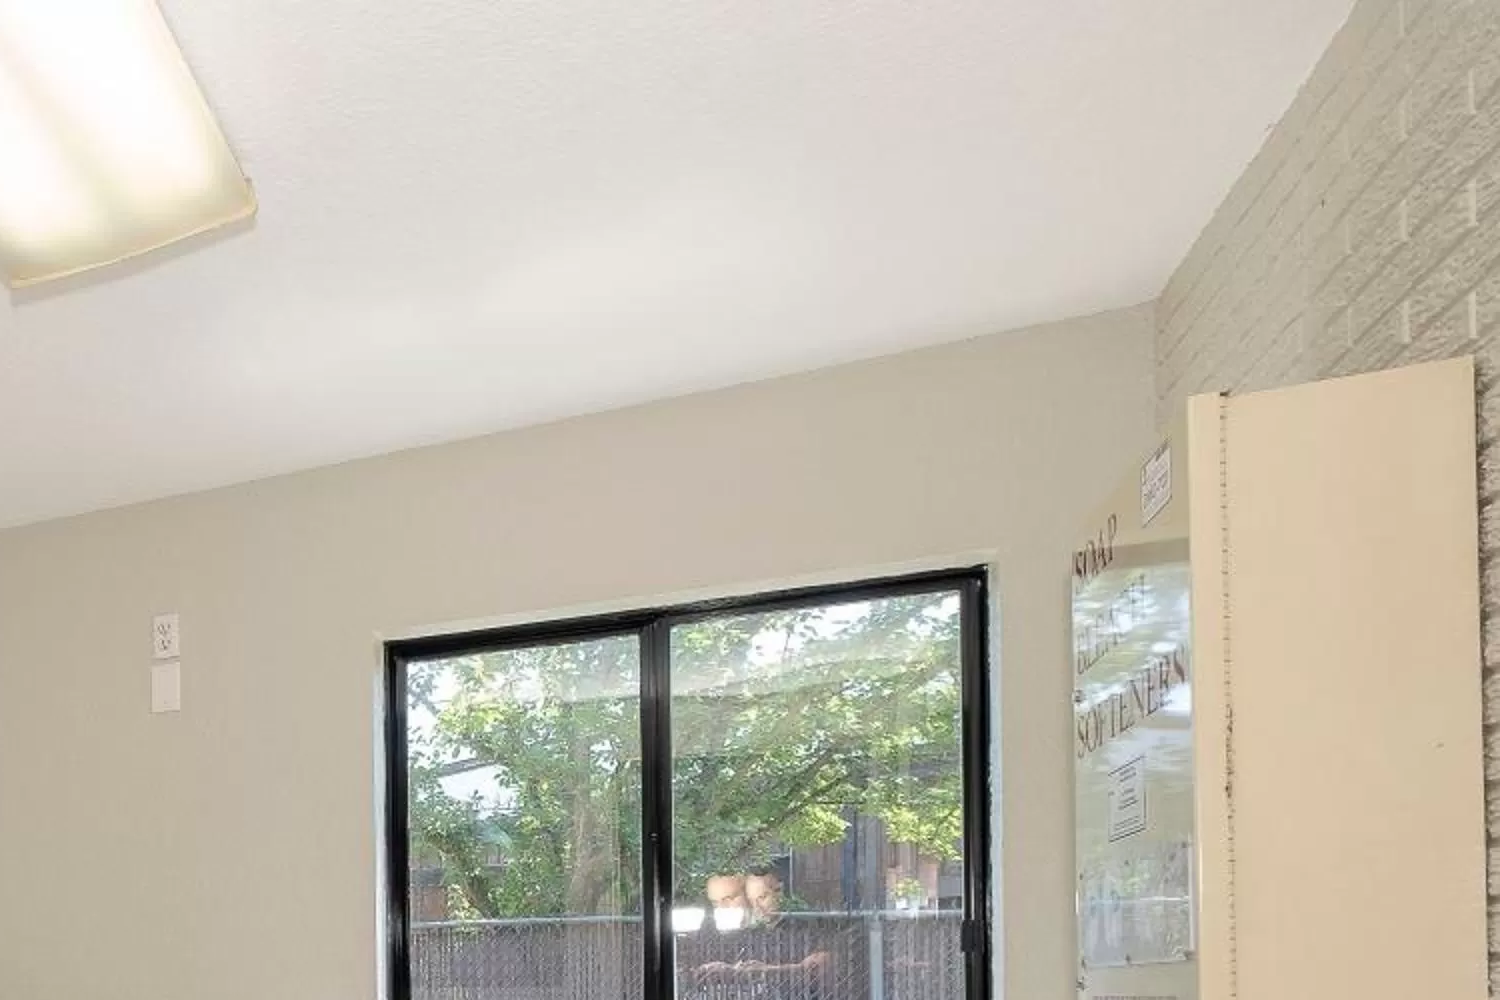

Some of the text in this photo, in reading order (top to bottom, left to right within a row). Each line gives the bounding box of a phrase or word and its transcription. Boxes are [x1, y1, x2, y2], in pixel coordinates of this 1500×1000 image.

[1074, 513, 1117, 582] SOAP
[1077, 574, 1146, 676] BLEAH
[1077, 646, 1186, 759] SOFTENERS
